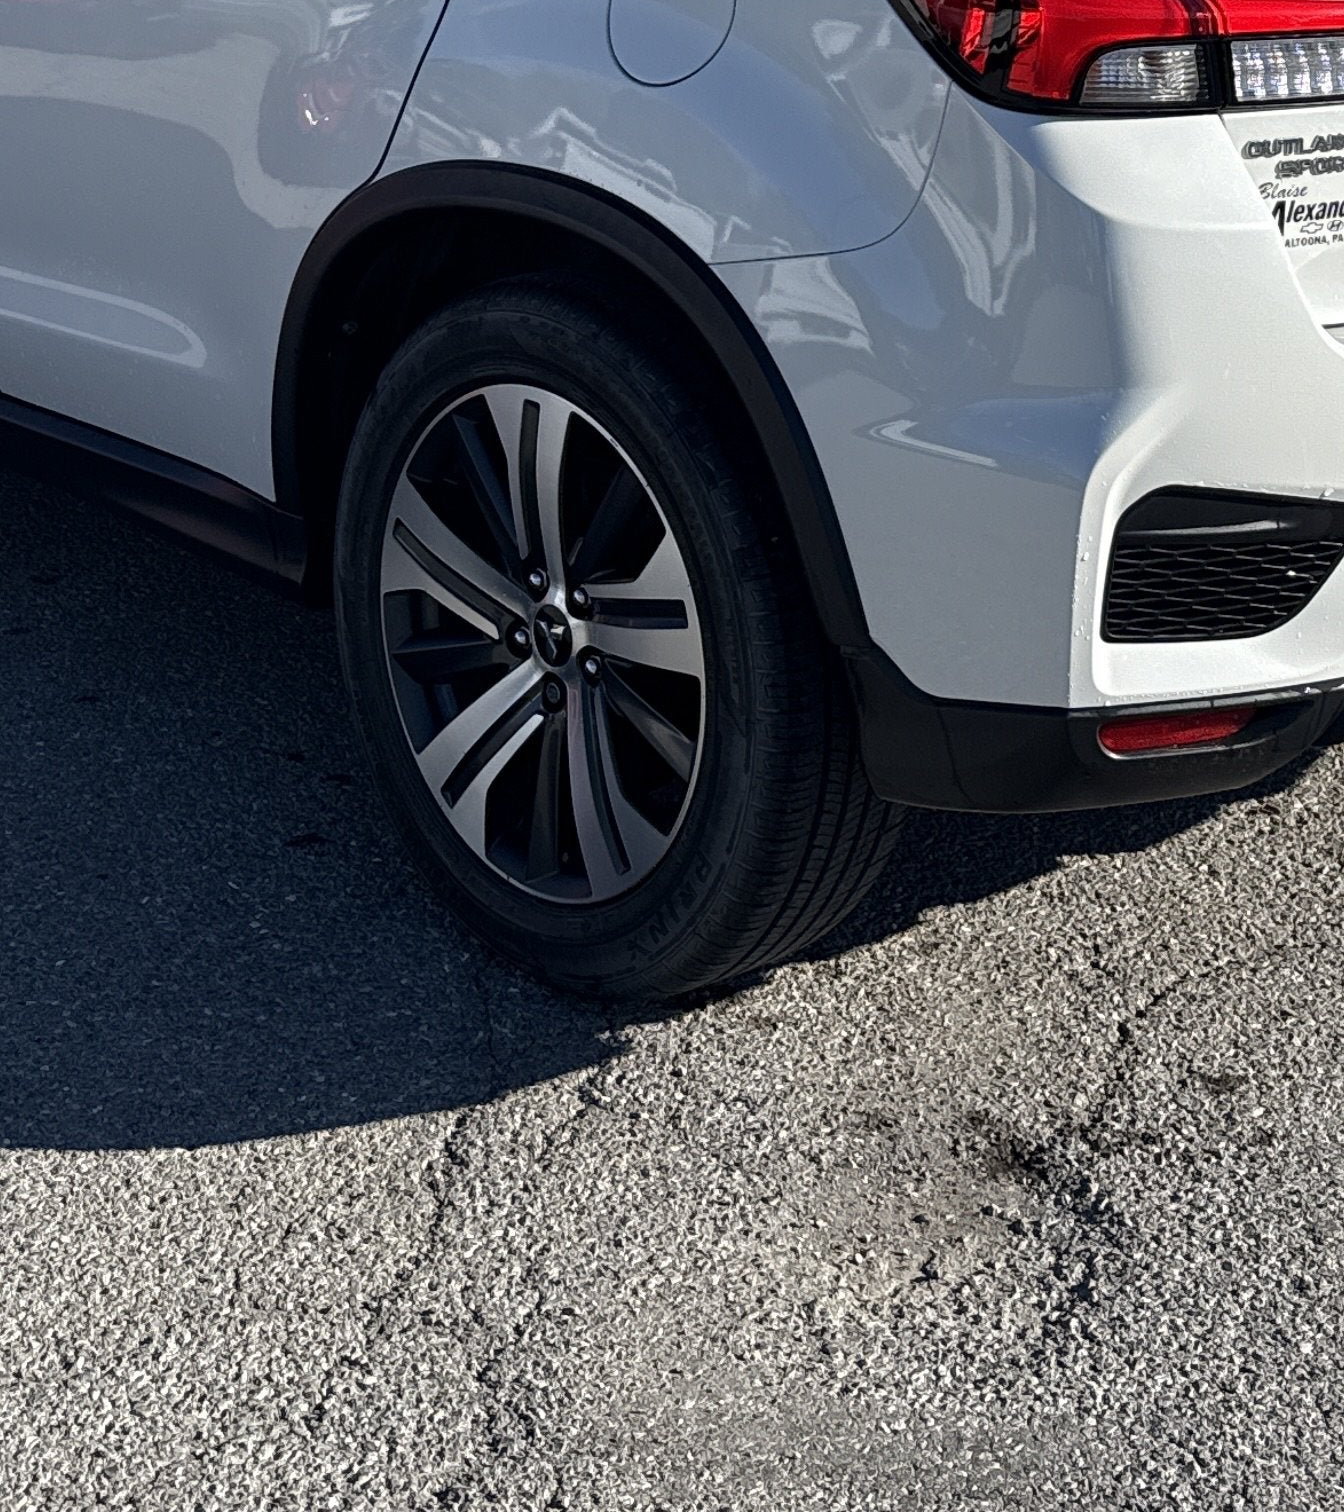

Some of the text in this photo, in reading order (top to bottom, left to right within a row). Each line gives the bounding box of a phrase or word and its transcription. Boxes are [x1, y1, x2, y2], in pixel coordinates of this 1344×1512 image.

[1258, 182, 1308, 199] Blaise
[1285, 234, 1344, 248] ALTOONA, PA
